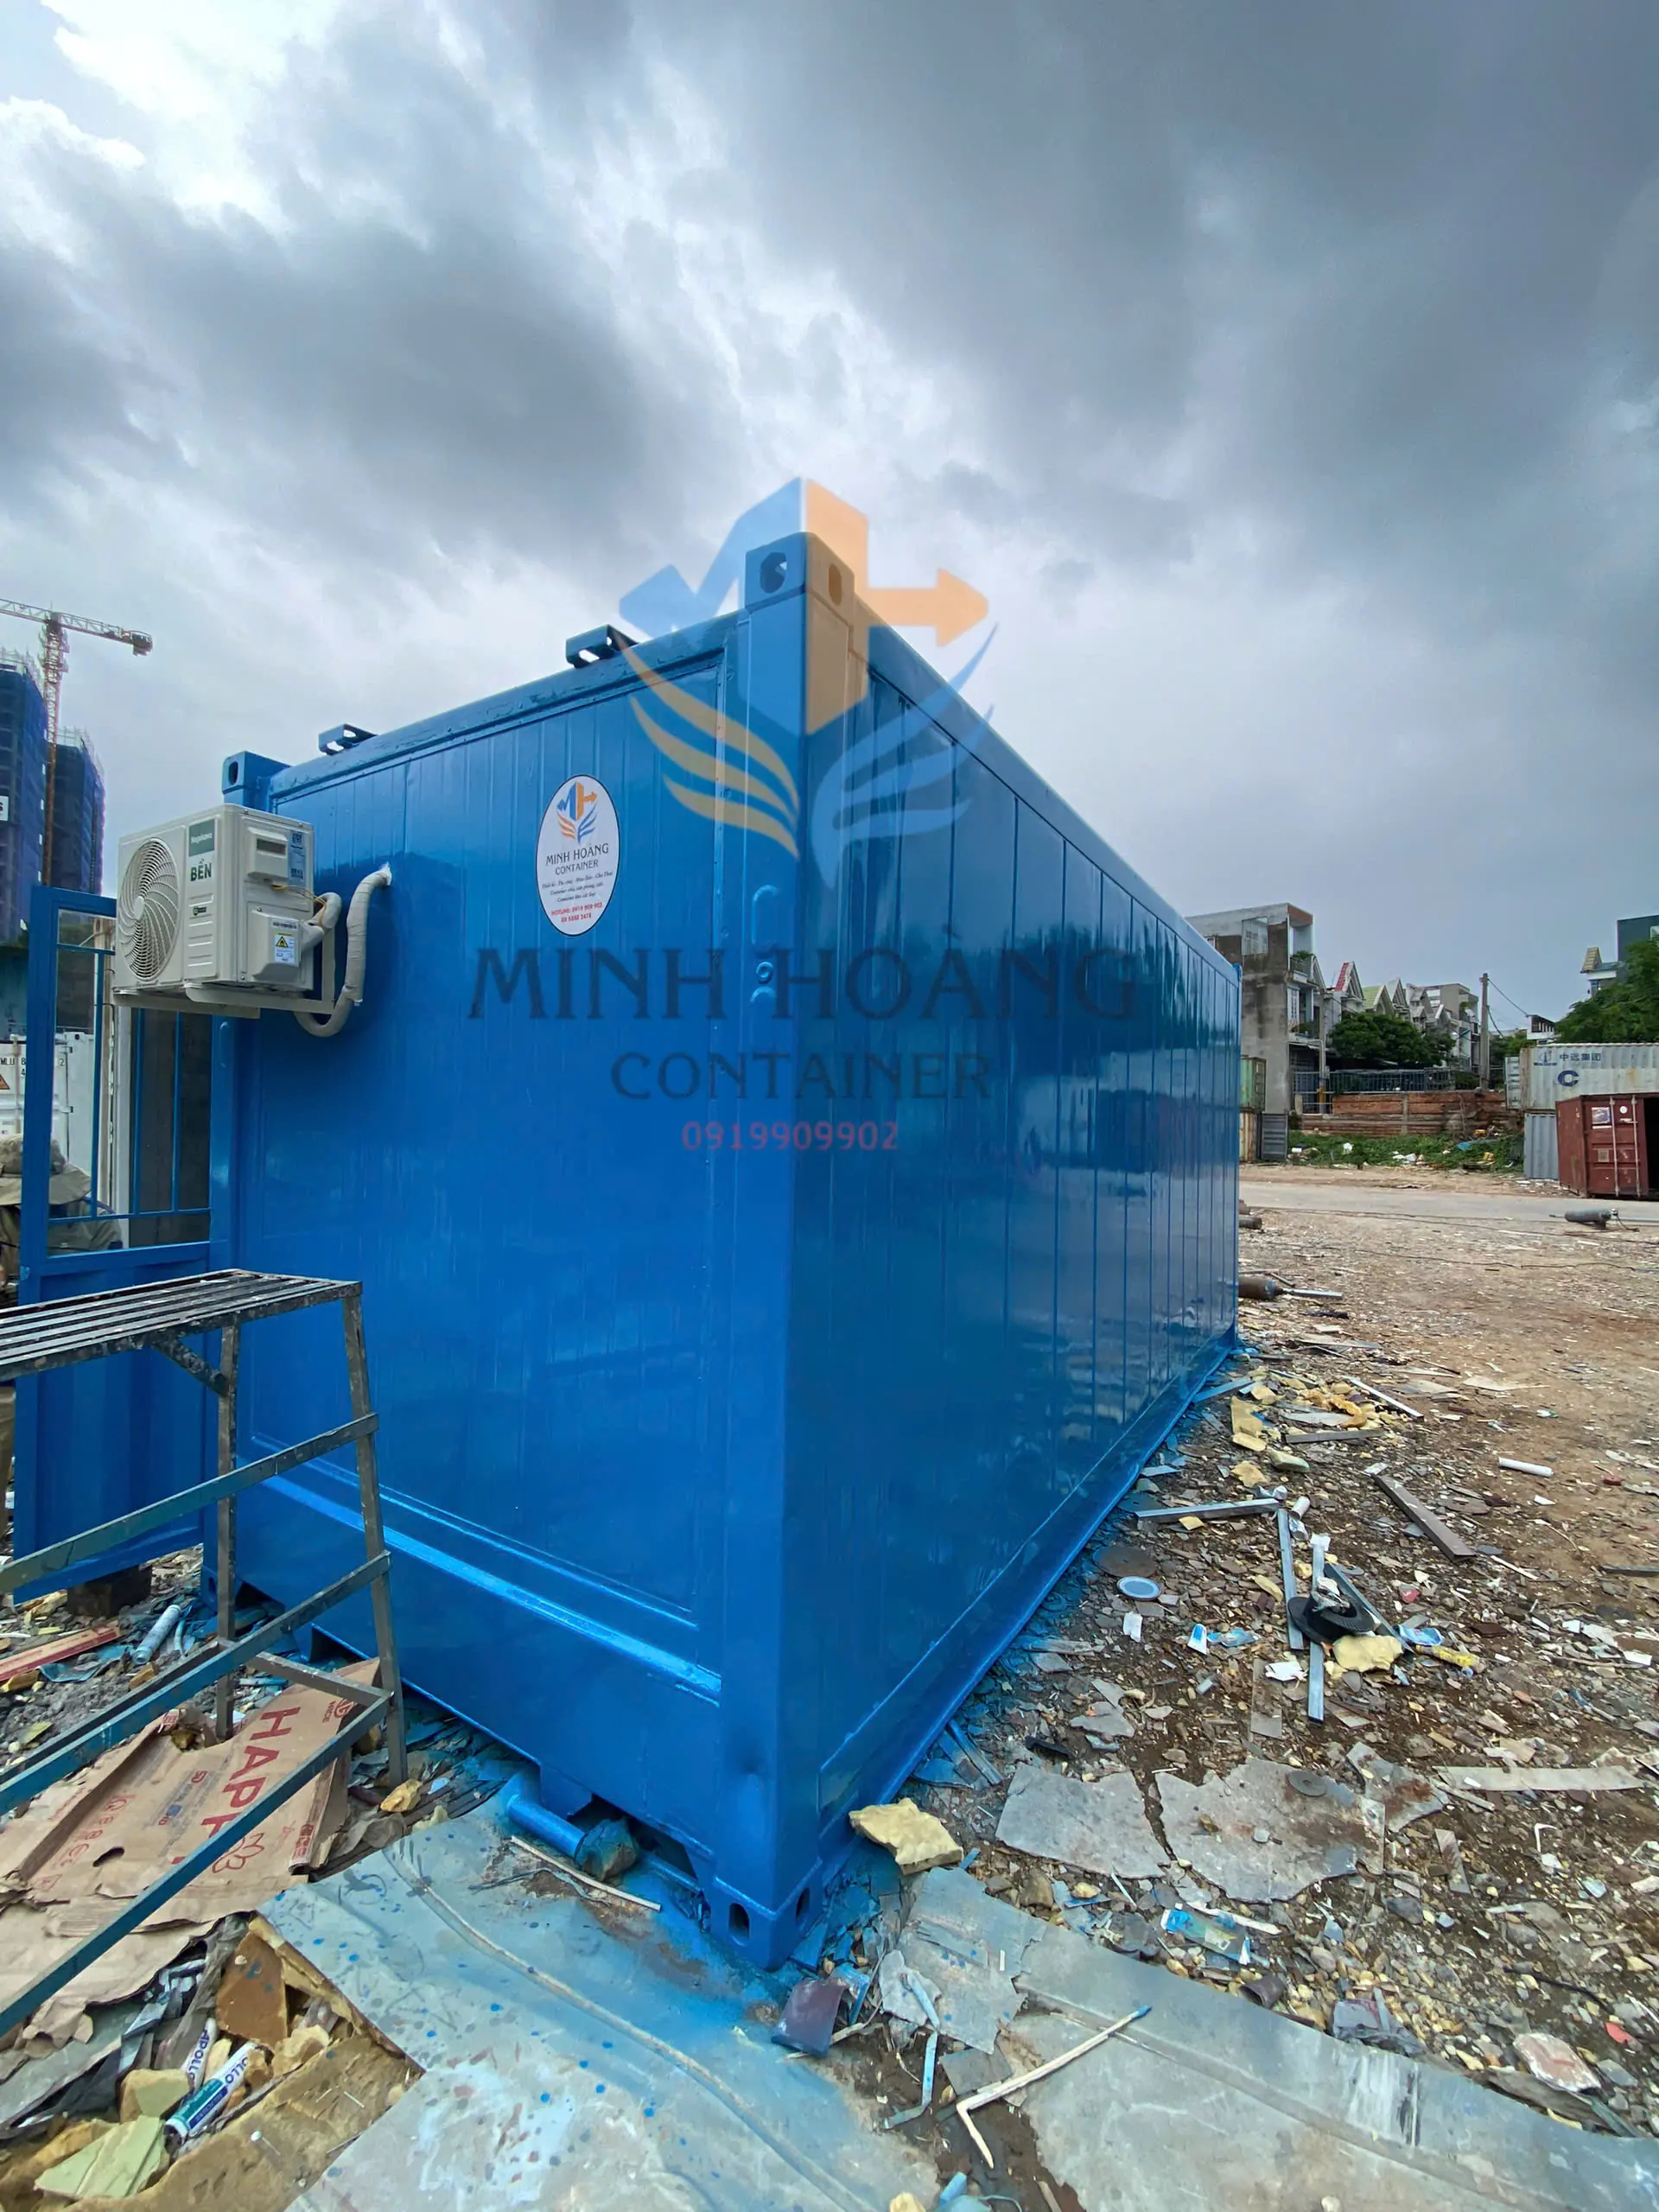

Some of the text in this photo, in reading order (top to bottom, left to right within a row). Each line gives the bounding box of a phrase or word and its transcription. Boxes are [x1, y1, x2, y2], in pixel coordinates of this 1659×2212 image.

[546, 851, 570, 867] MINH
[555, 859, 599, 875] CONTAINER
[172, 1707, 301, 1865] HAP
[225, 2056, 249, 2084] OLLO
